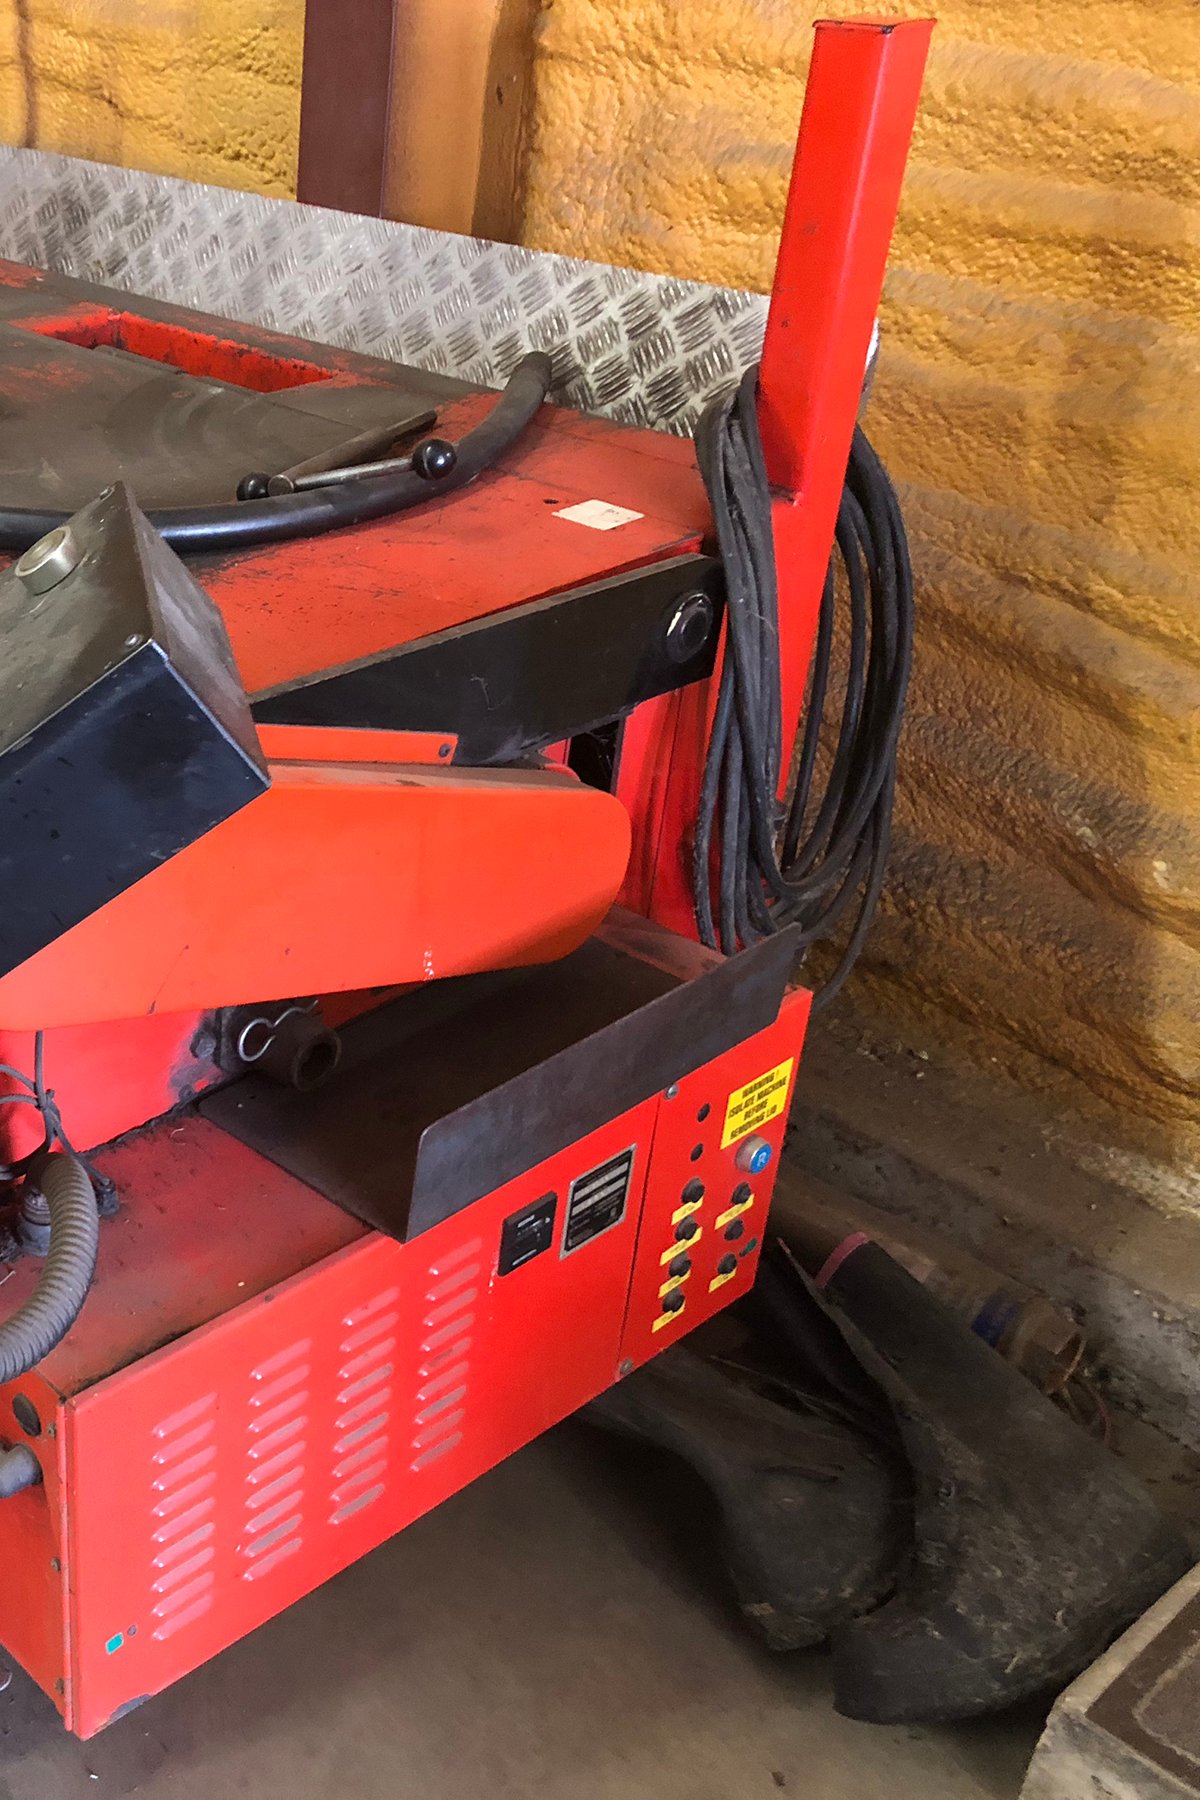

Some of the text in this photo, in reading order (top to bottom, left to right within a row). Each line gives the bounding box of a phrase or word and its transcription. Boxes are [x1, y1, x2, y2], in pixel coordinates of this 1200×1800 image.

[742, 1071, 775, 1098] WARNING
[756, 1075, 787, 1102] MACHINE
[743, 1098, 769, 1121] BEFORE
